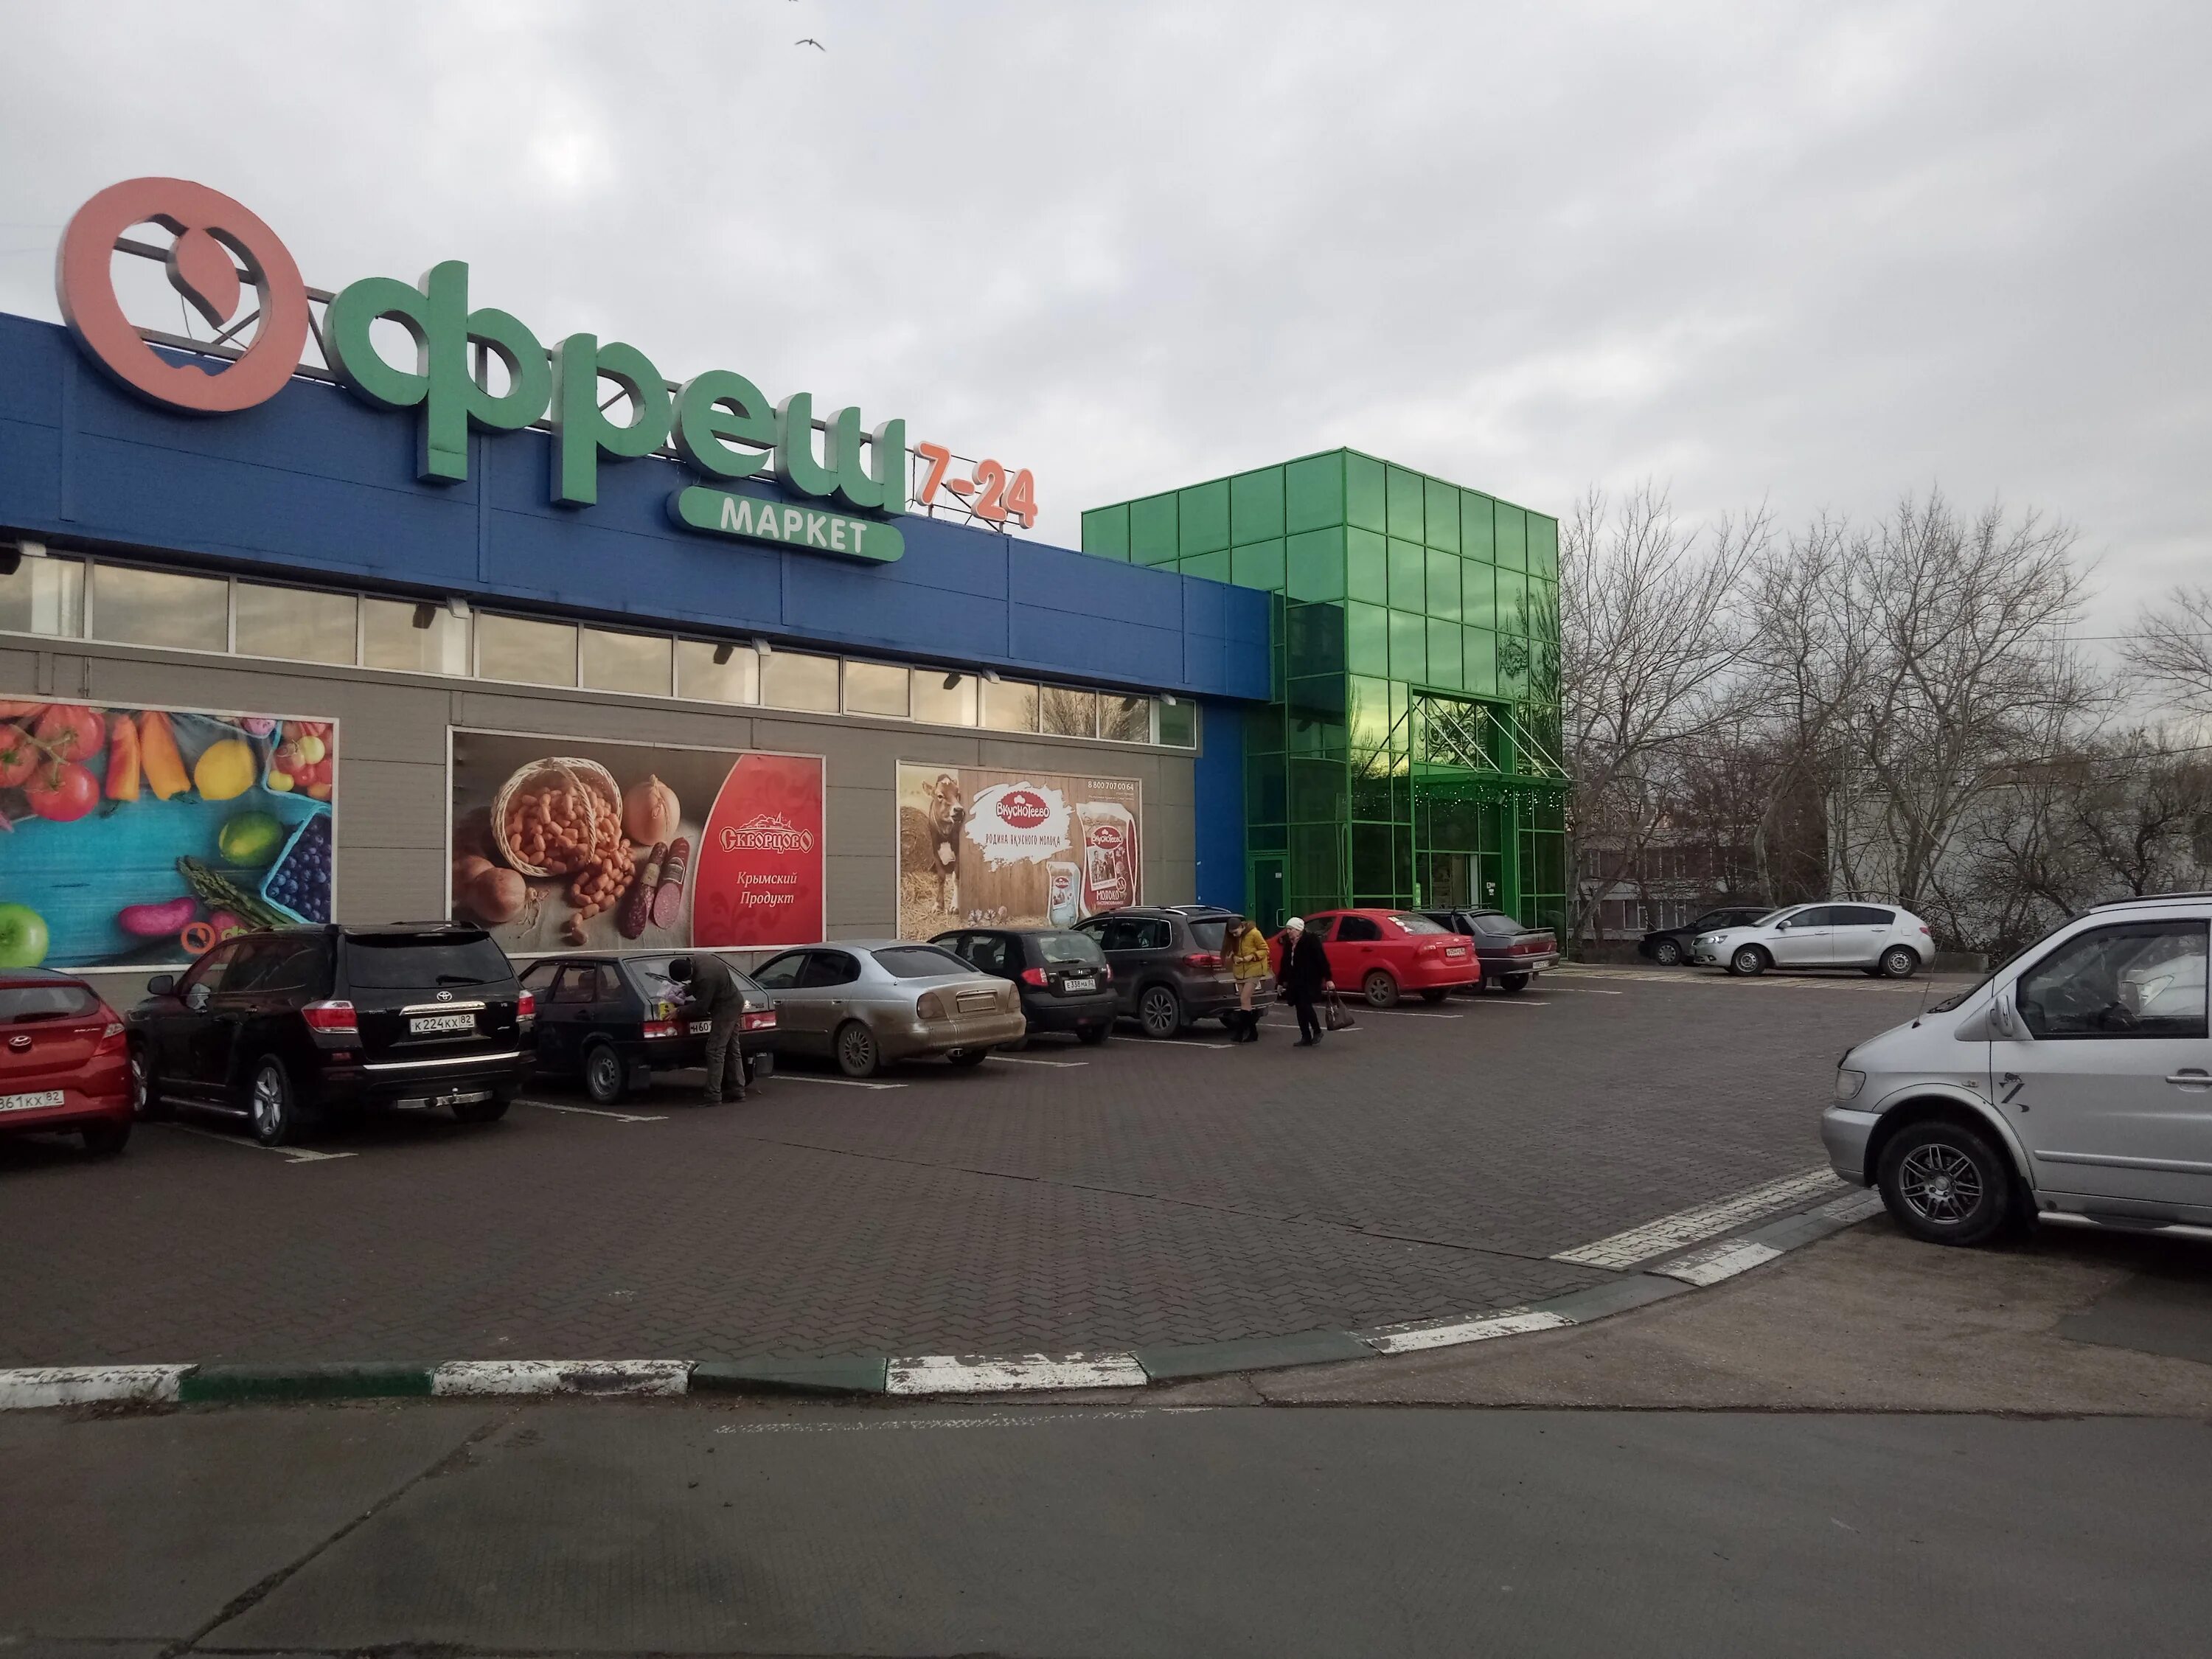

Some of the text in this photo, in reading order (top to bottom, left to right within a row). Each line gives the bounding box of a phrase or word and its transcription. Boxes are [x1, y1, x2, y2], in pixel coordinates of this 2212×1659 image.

[914, 440, 1038, 529] 7-24
[720, 497, 867, 553] МАРКЕТ
[986, 834, 1060, 847] РОДИНА ВКУСНОГО МОЛОКА
[737, 872, 797, 888] Крымский
[740, 891, 794, 908] Продукт
[1096, 890, 1119, 900] МОЛОКО
[46, 1091, 59, 1101] 82
